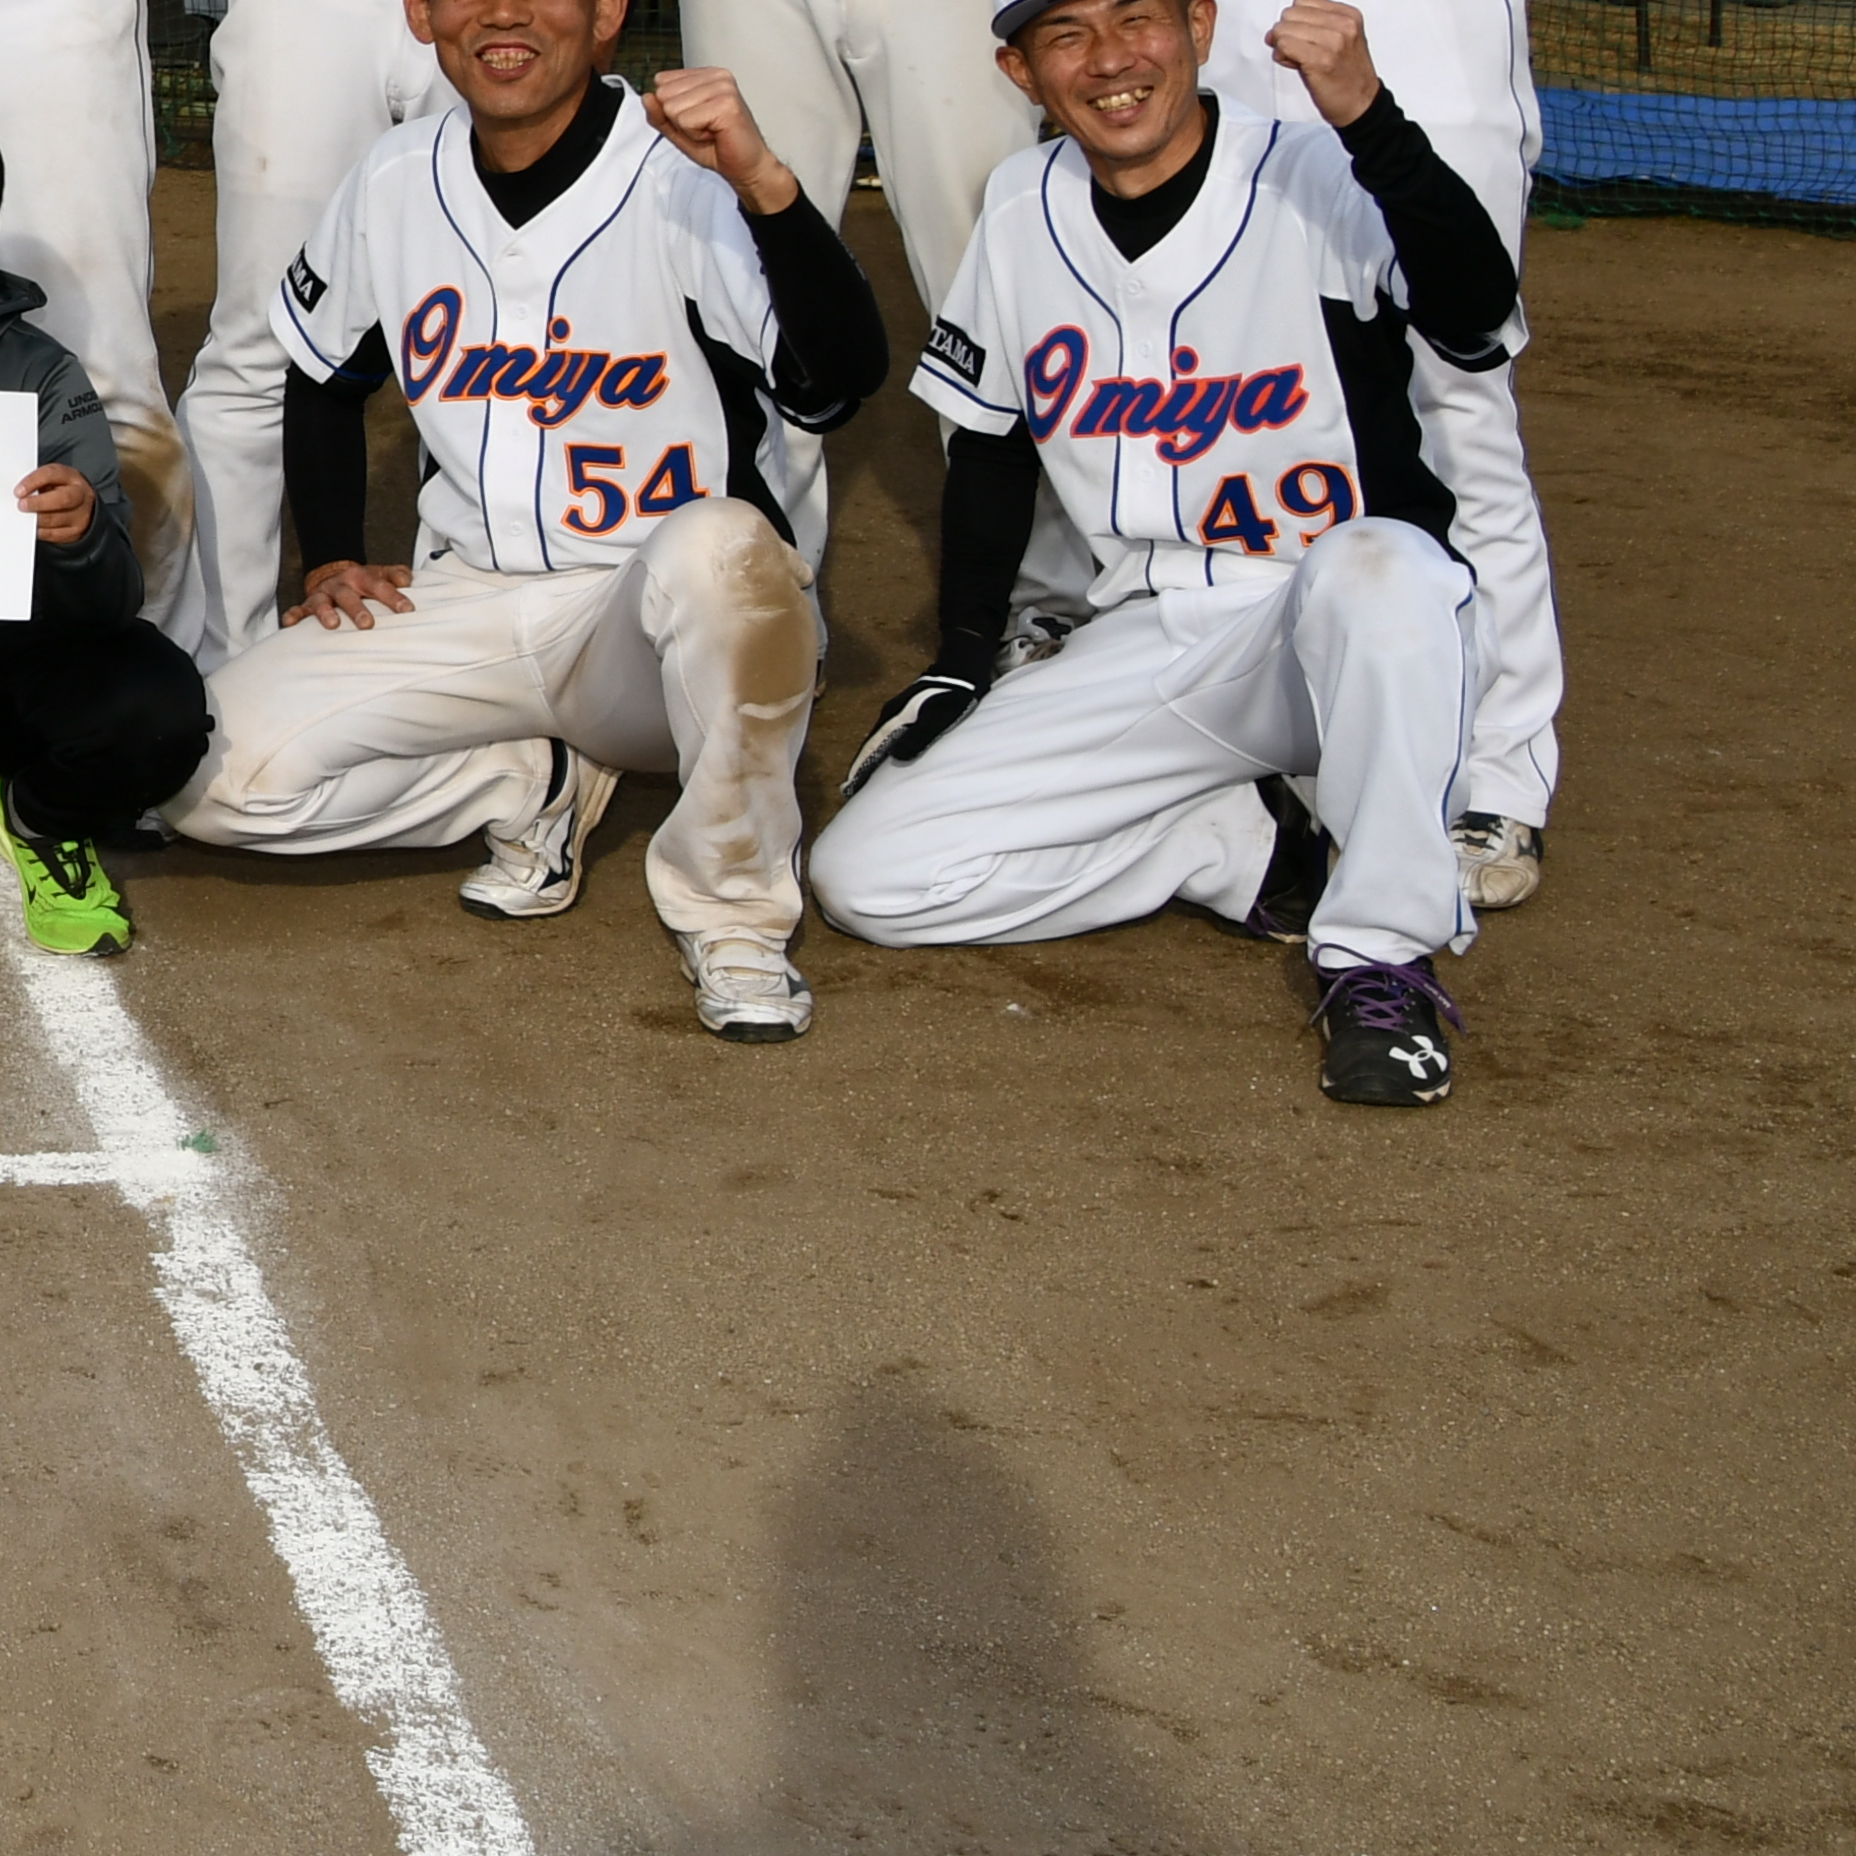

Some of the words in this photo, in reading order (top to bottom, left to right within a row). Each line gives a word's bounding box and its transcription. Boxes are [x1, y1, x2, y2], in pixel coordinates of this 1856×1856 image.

[400, 284, 670, 429] Omiya
[1023, 322, 1310, 466] Omiya
[561, 441, 709, 537] 54
[1197, 460, 1358, 556] 49
